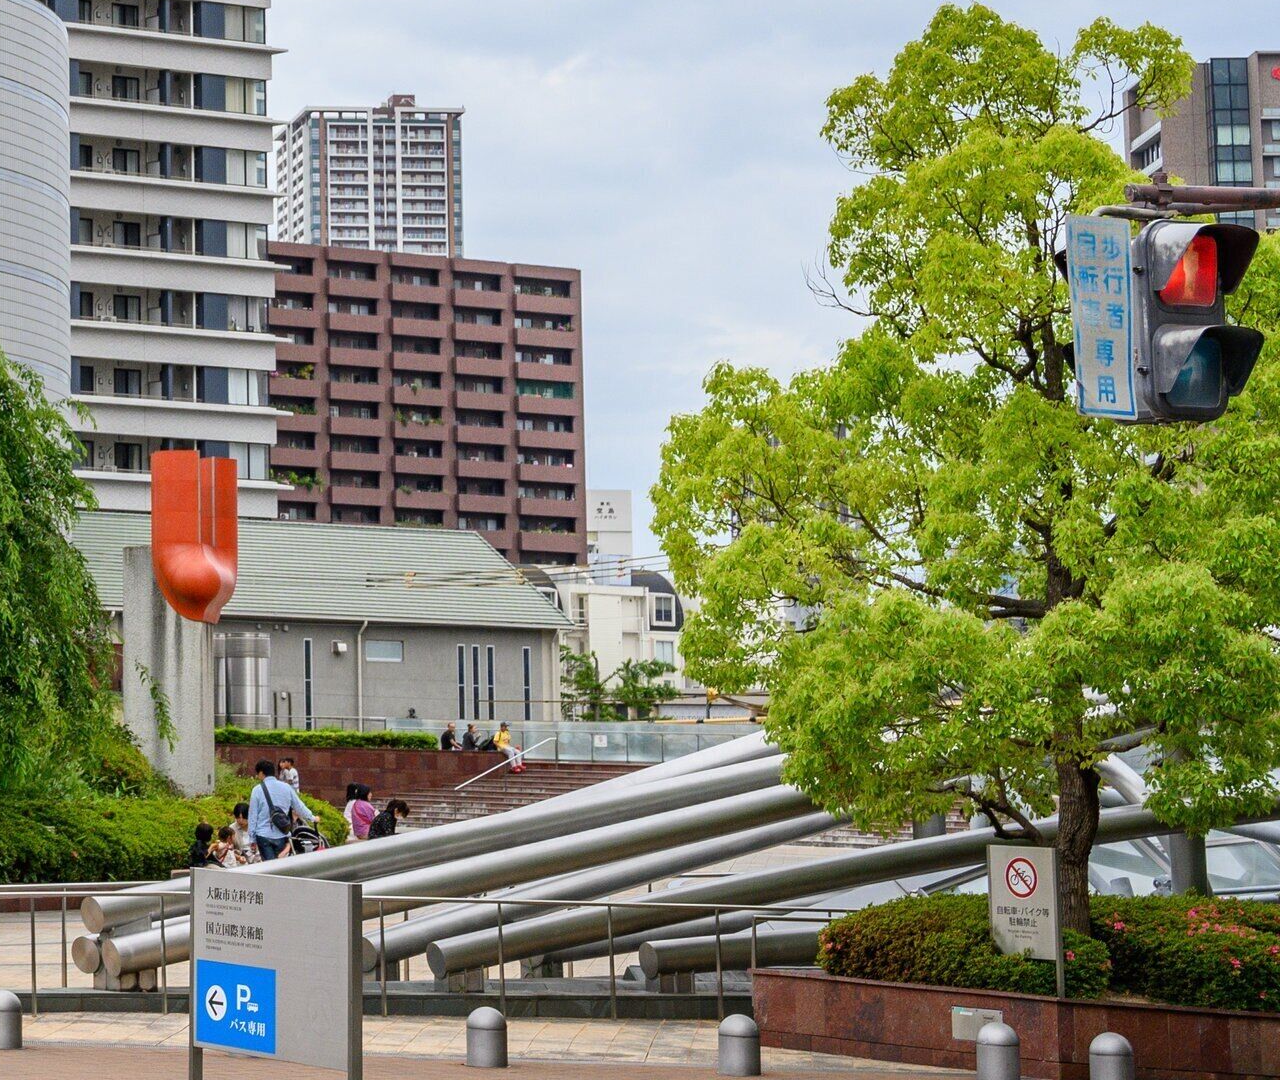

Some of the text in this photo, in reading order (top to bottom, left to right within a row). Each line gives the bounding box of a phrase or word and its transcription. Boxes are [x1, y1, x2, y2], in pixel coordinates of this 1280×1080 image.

[1095, 339, 1117, 404] 専用
[206, 886, 264, 905] 大阪市立科学館
[997, 906, 1049, 917] 自転車・バイク等
[205, 921, 264, 940] 国立国際美術館
[1009, 917, 1038, 927] 駐輪禁止
[236, 984, 252, 1011] P
[229, 1018, 265, 1038] バス専用
